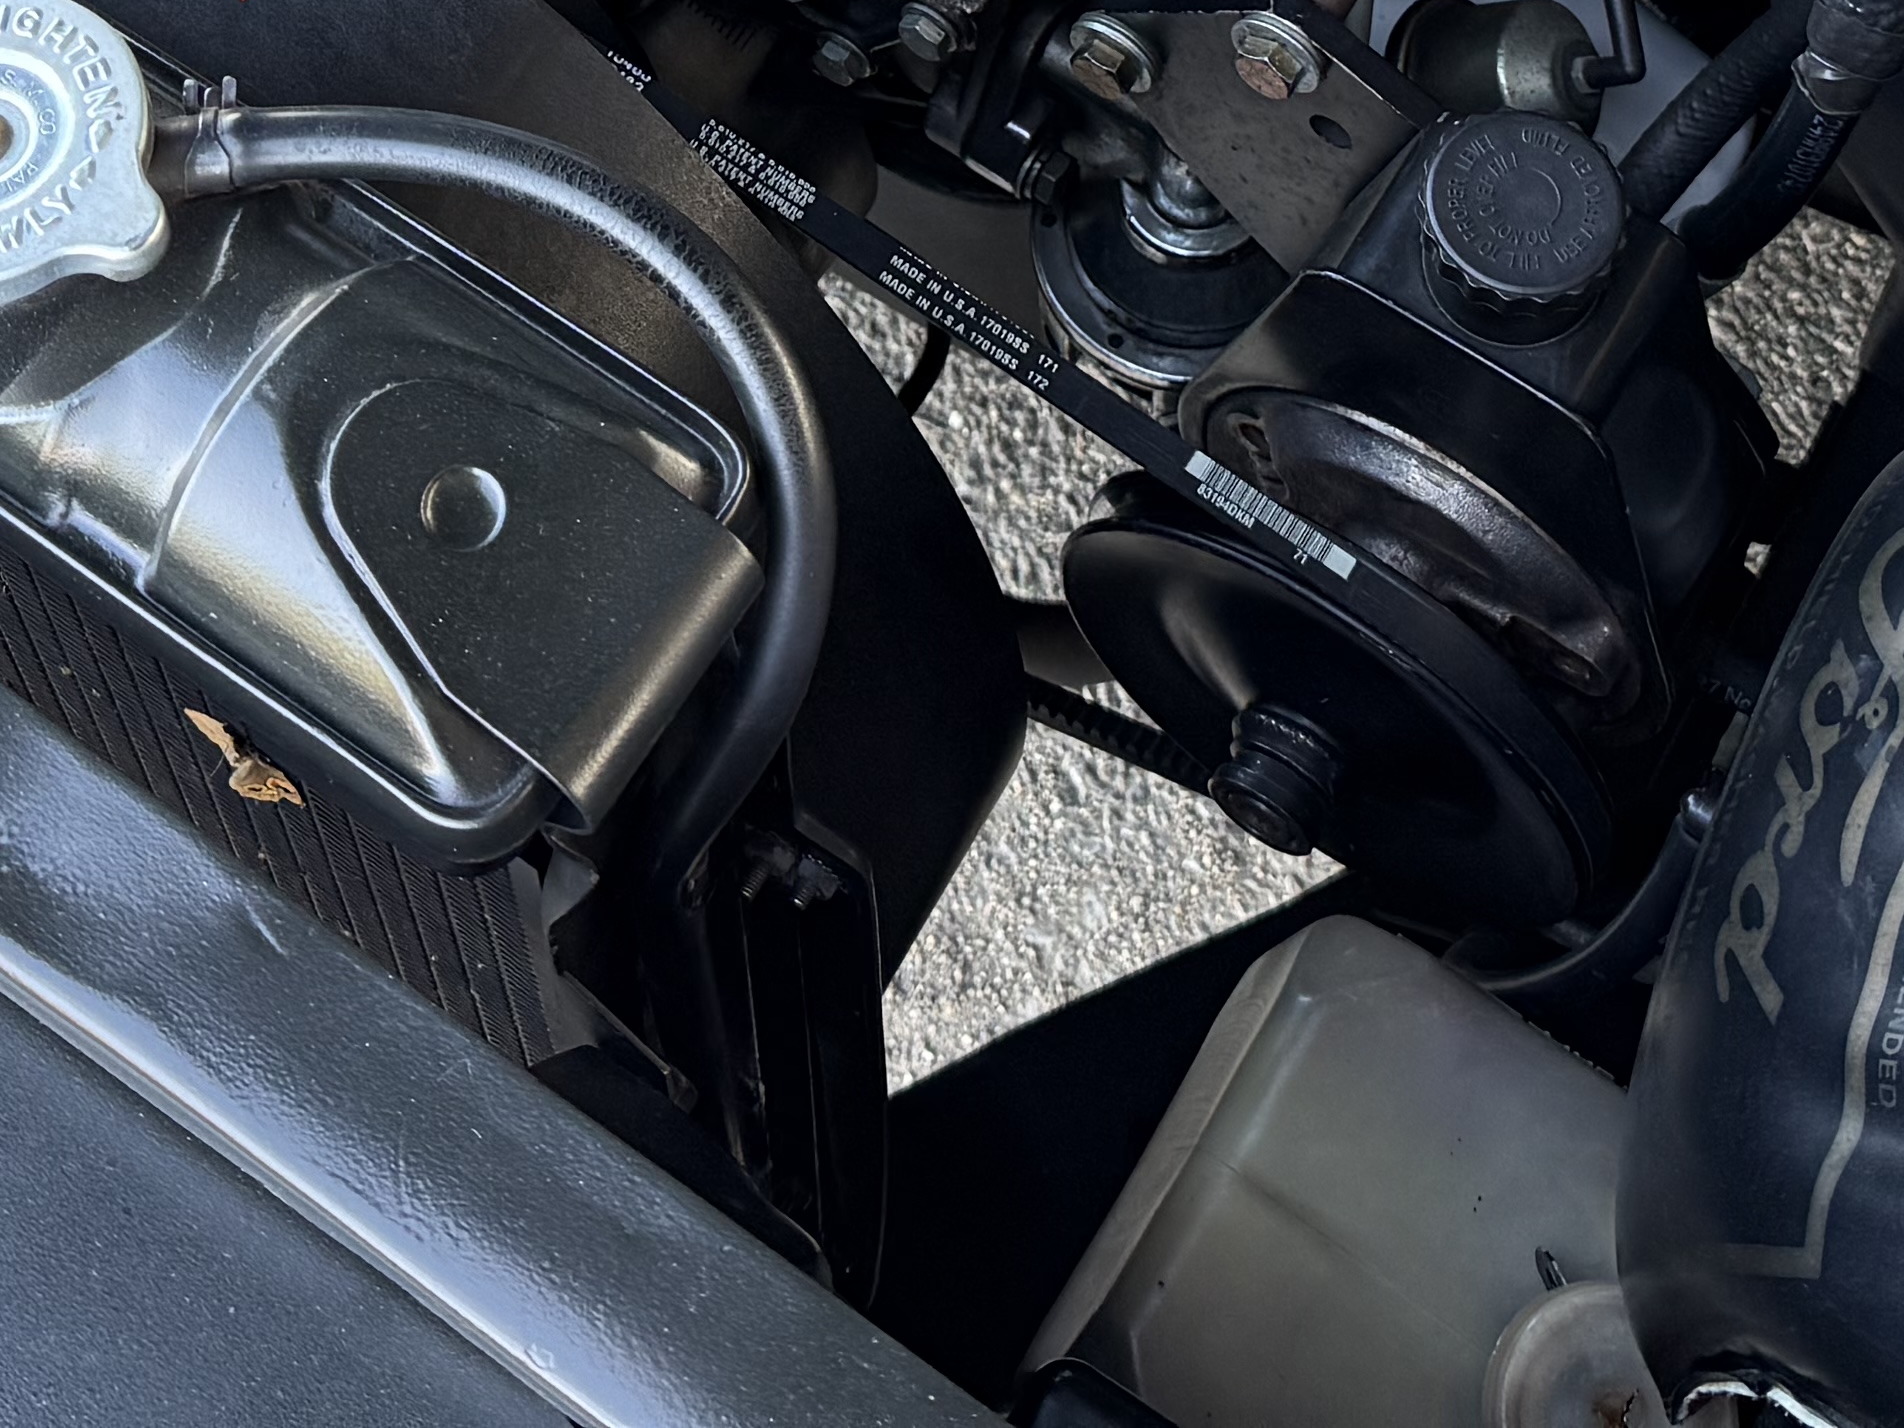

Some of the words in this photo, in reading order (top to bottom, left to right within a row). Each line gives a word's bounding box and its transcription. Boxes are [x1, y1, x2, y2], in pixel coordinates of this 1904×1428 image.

[1446, 177, 1477, 243] PROPER
[1525, 227, 1552, 246] DO
[878, 269, 917, 301] MADE
[914, 294, 932, 312] IN
[1025, 369, 1051, 392] 172
[889, 254, 928, 285] MADE
[926, 279, 943, 295] IN
[1037, 352, 1060, 375] 171
[1196, 482, 1256, 530] 83194DKM
[1292, 548, 1309, 566] 71
